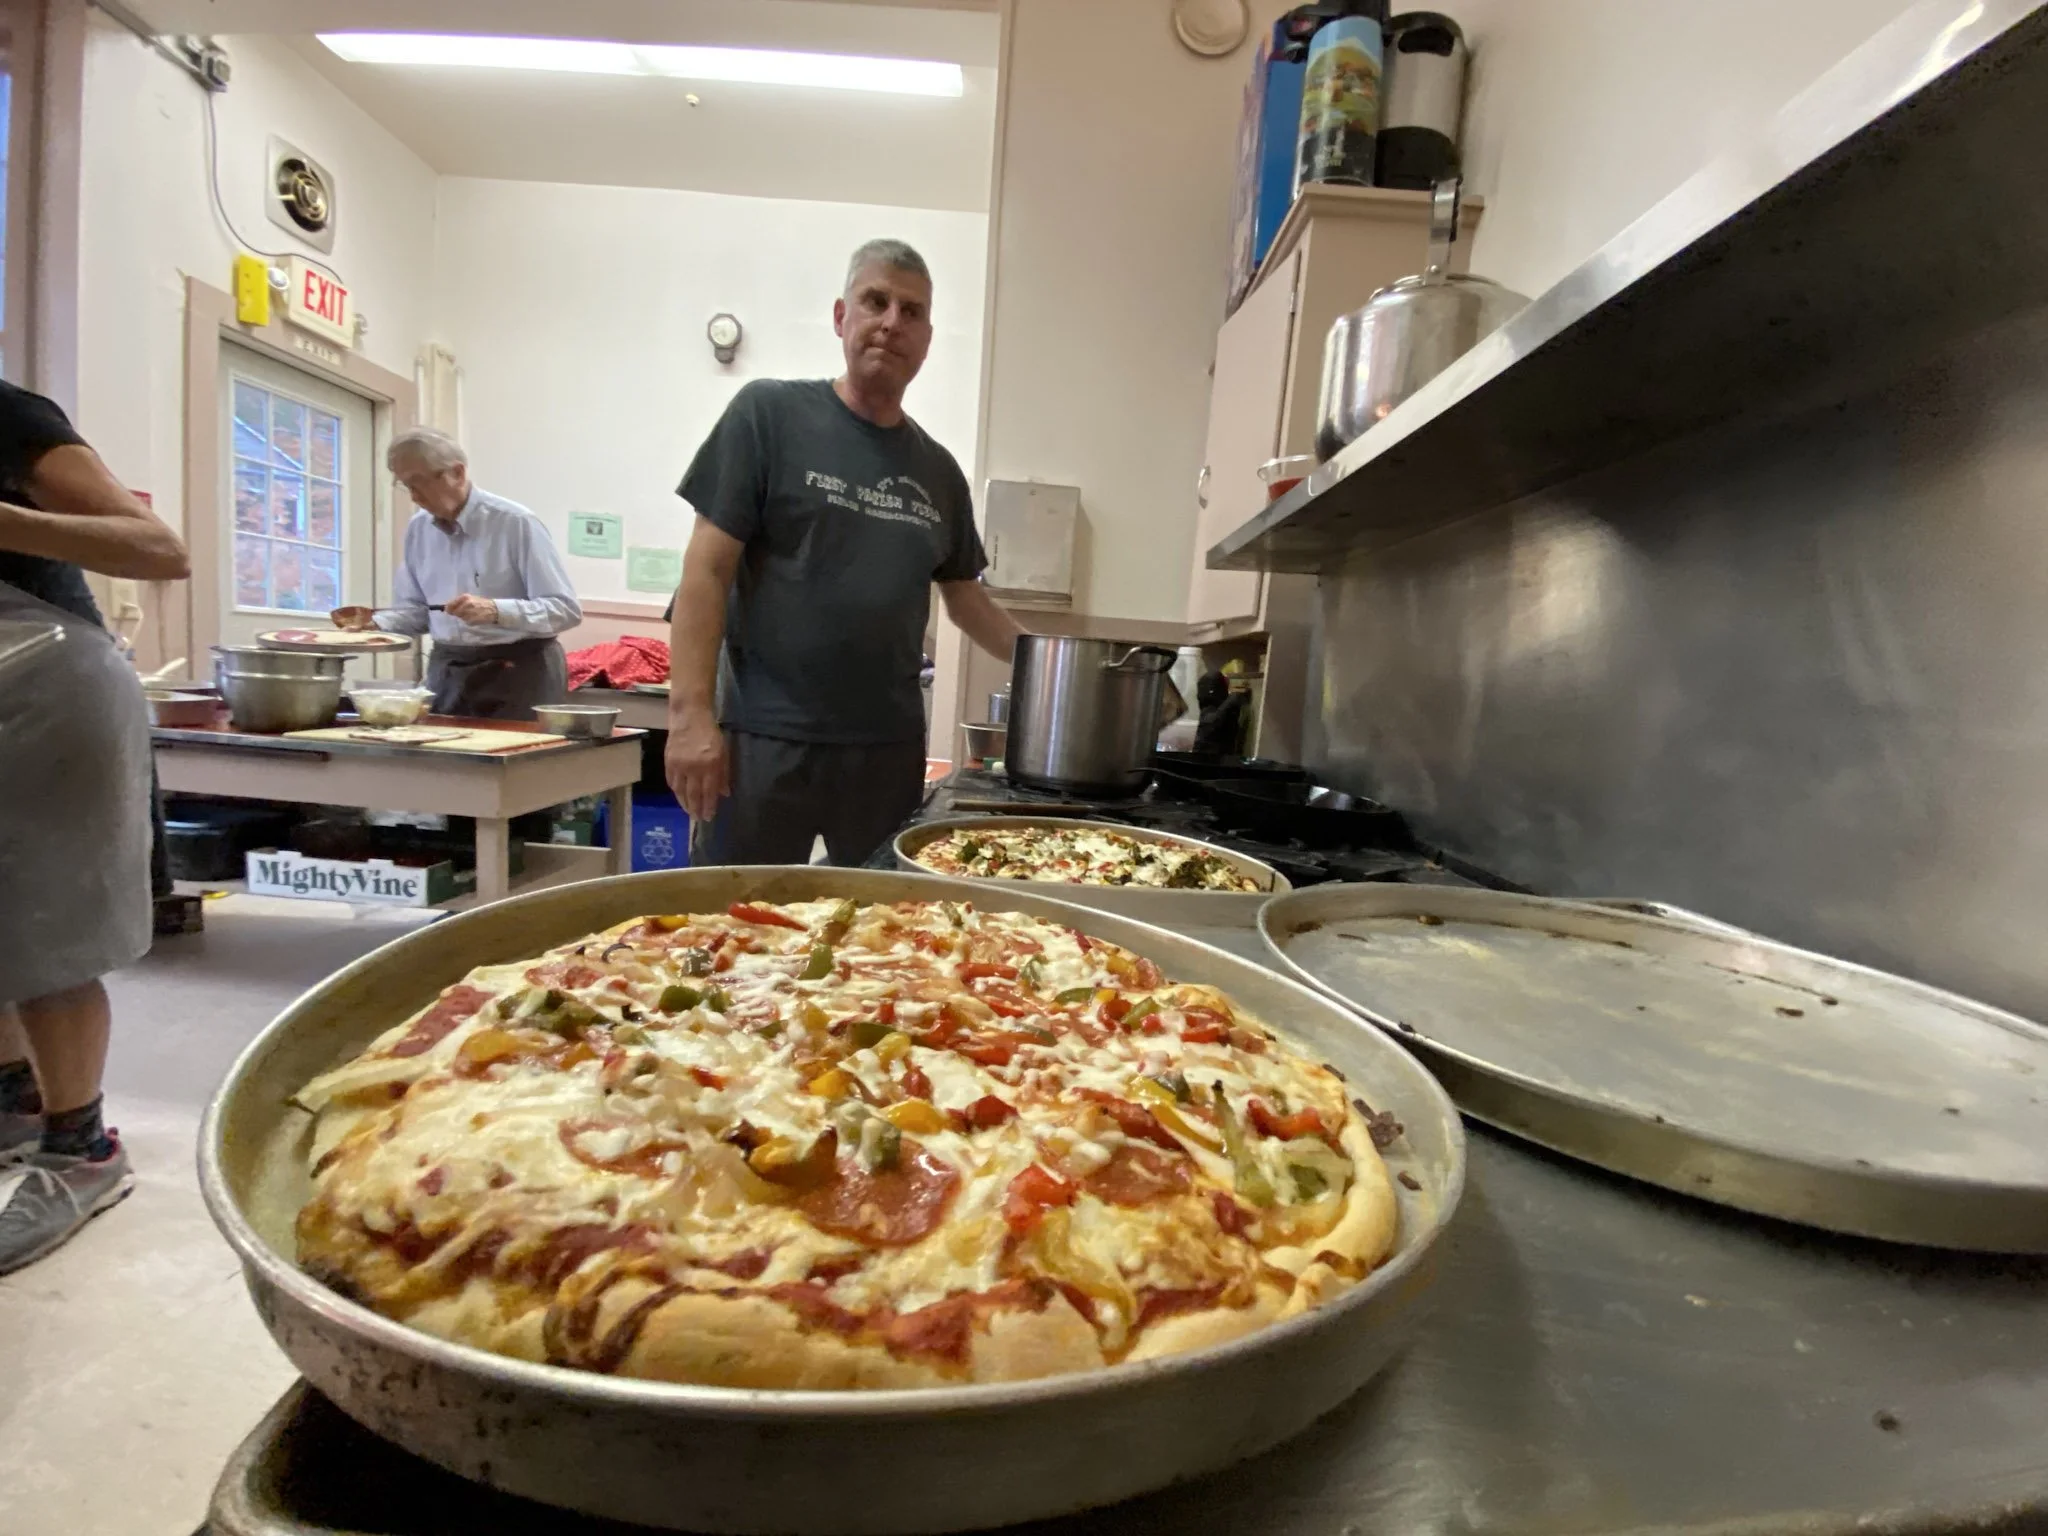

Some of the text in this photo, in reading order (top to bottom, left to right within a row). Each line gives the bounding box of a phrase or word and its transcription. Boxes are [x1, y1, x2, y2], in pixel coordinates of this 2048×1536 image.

[305, 270, 347, 325] EXIT
[303, 340, 333, 361] EXIT
[258, 860, 417, 897] MightyVine
